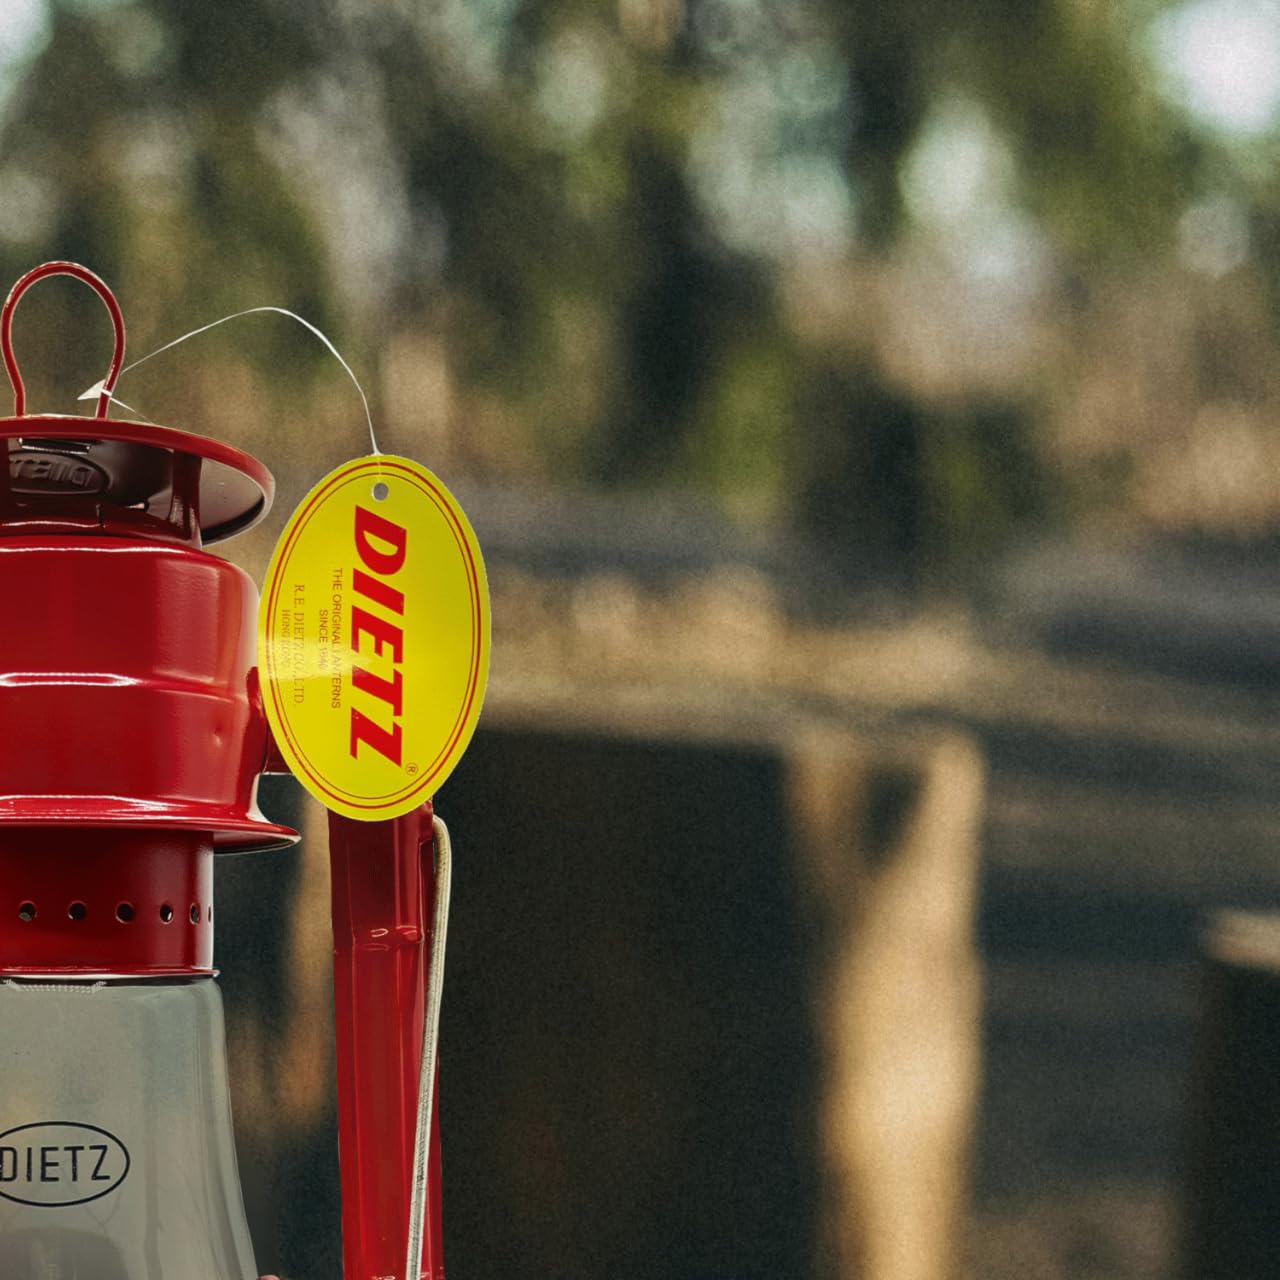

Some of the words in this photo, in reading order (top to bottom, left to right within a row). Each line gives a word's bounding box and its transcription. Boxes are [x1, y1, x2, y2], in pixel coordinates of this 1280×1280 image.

[332, 568, 343, 591] THE
[318, 609, 329, 644] SINCE
[331, 594, 342, 645] ORIGINAL
[350, 505, 408, 768] DIETZ
